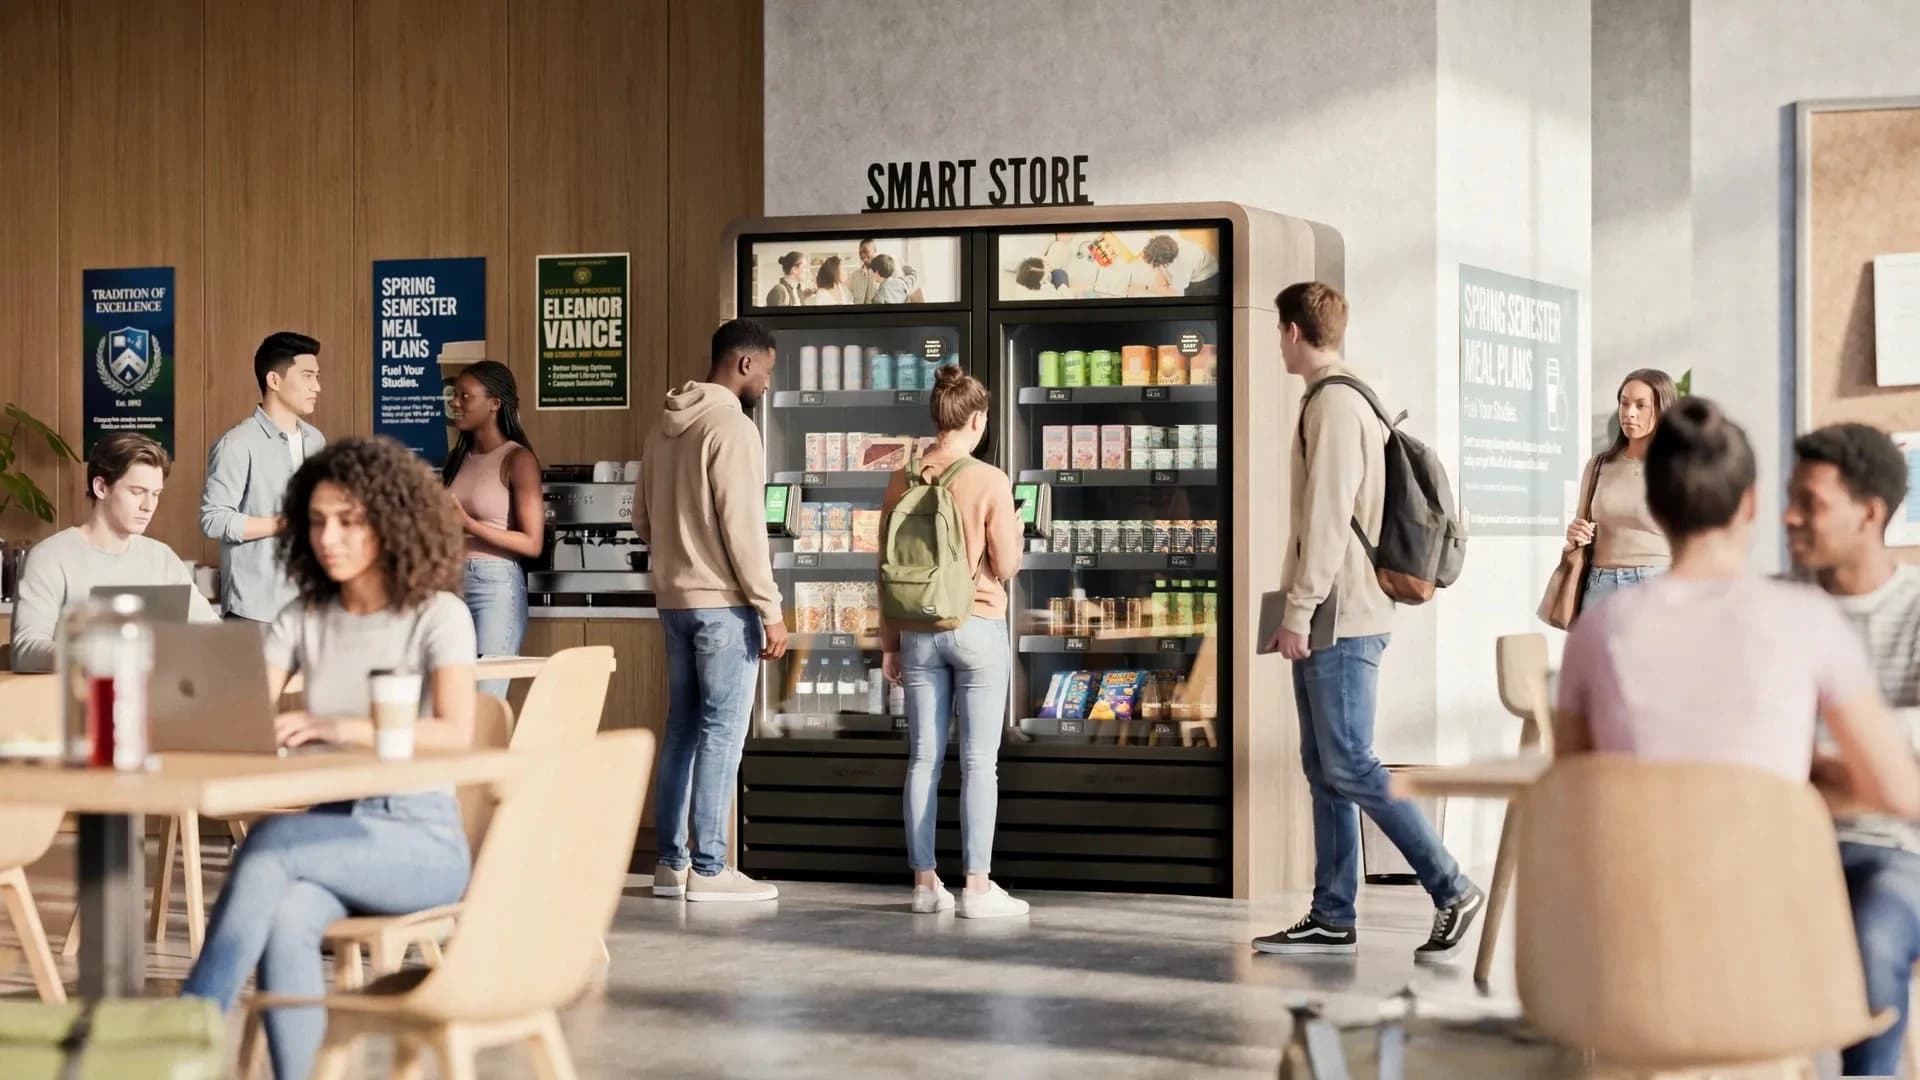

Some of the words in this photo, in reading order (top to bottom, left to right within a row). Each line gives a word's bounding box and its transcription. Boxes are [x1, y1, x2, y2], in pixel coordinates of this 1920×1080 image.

[867, 159, 976, 209] SMART
[988, 155, 1088, 206] STORE
[92, 288, 149, 300] TRADITION
[151, 287, 166, 299] OF
[382, 276, 435, 296] SPRING
[96, 301, 162, 313] EXCELLENCE
[382, 297, 457, 317] SEMESTER
[543, 296, 622, 319] ELEANOR
[1464, 284, 1506, 335] SPRING
[1507, 293, 1561, 345] SEMESTER
[382, 319, 422, 338] MEAL
[543, 319, 622, 349] VANCE
[382, 340, 429, 359] PLANS
[382, 365, 401, 376] Fuel
[403, 364, 425, 375] Your
[1464, 338, 1495, 386] MEAL
[1497, 343, 1533, 391] PLANS
[381, 377, 419, 388] Studies.
[579, 372, 599, 380] Library
